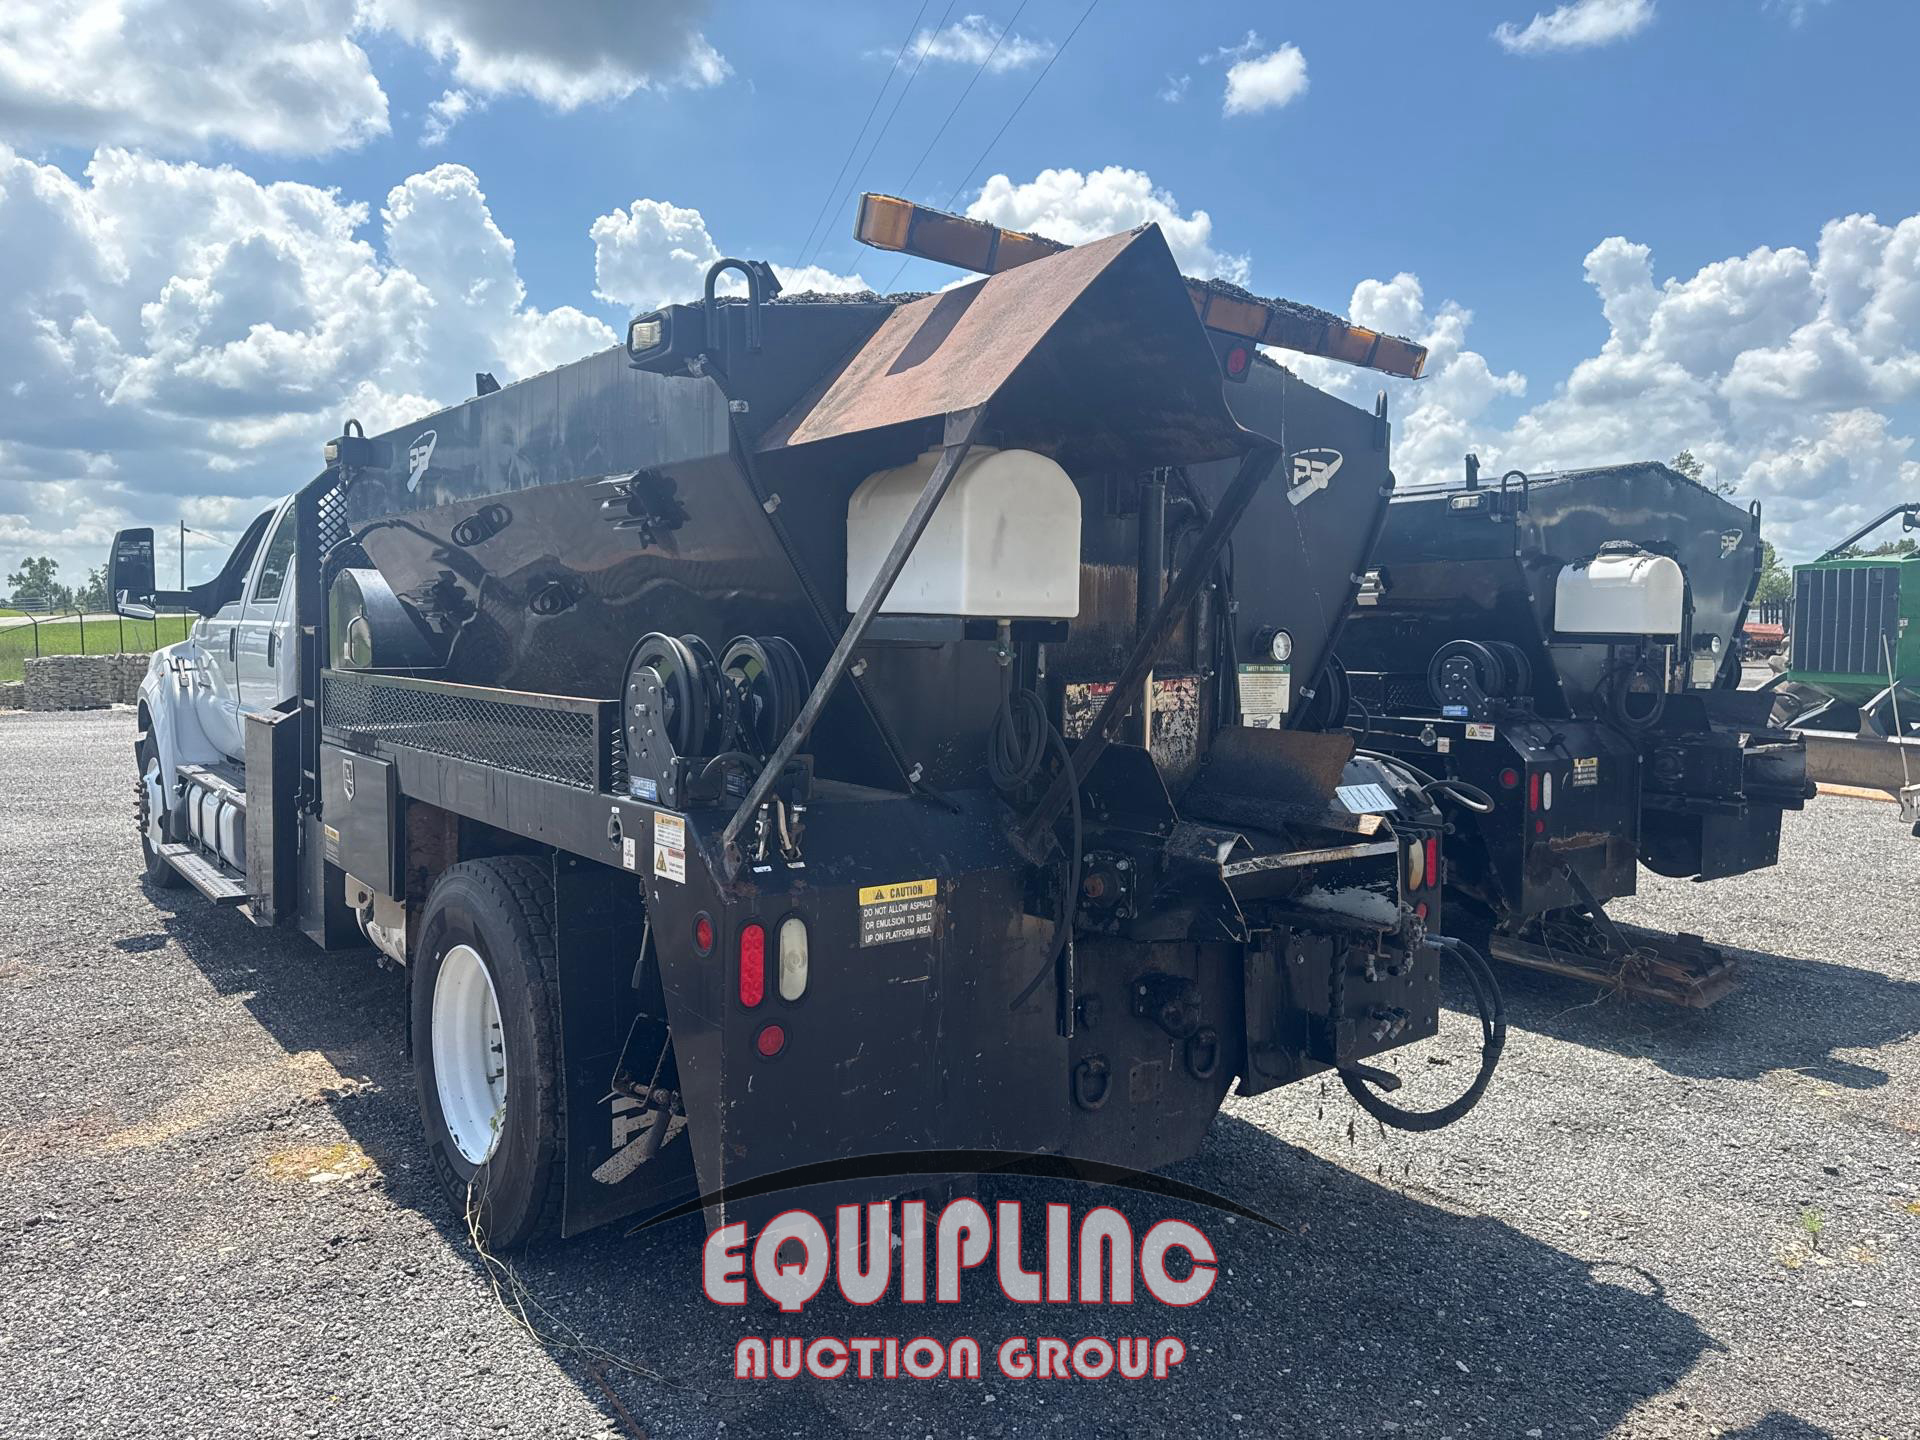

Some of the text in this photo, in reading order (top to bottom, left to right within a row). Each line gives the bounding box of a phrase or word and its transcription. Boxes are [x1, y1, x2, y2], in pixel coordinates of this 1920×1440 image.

[890, 885, 923, 898] CAUTION
[864, 900, 933, 918] DO NOT ALLOW ASPHALT
[865, 912, 932, 930] OR EMULSION TO BUILD
[865, 935, 874, 943] UP
[875, 933, 884, 942] ON
[886, 928, 915, 940] PLATFORM
